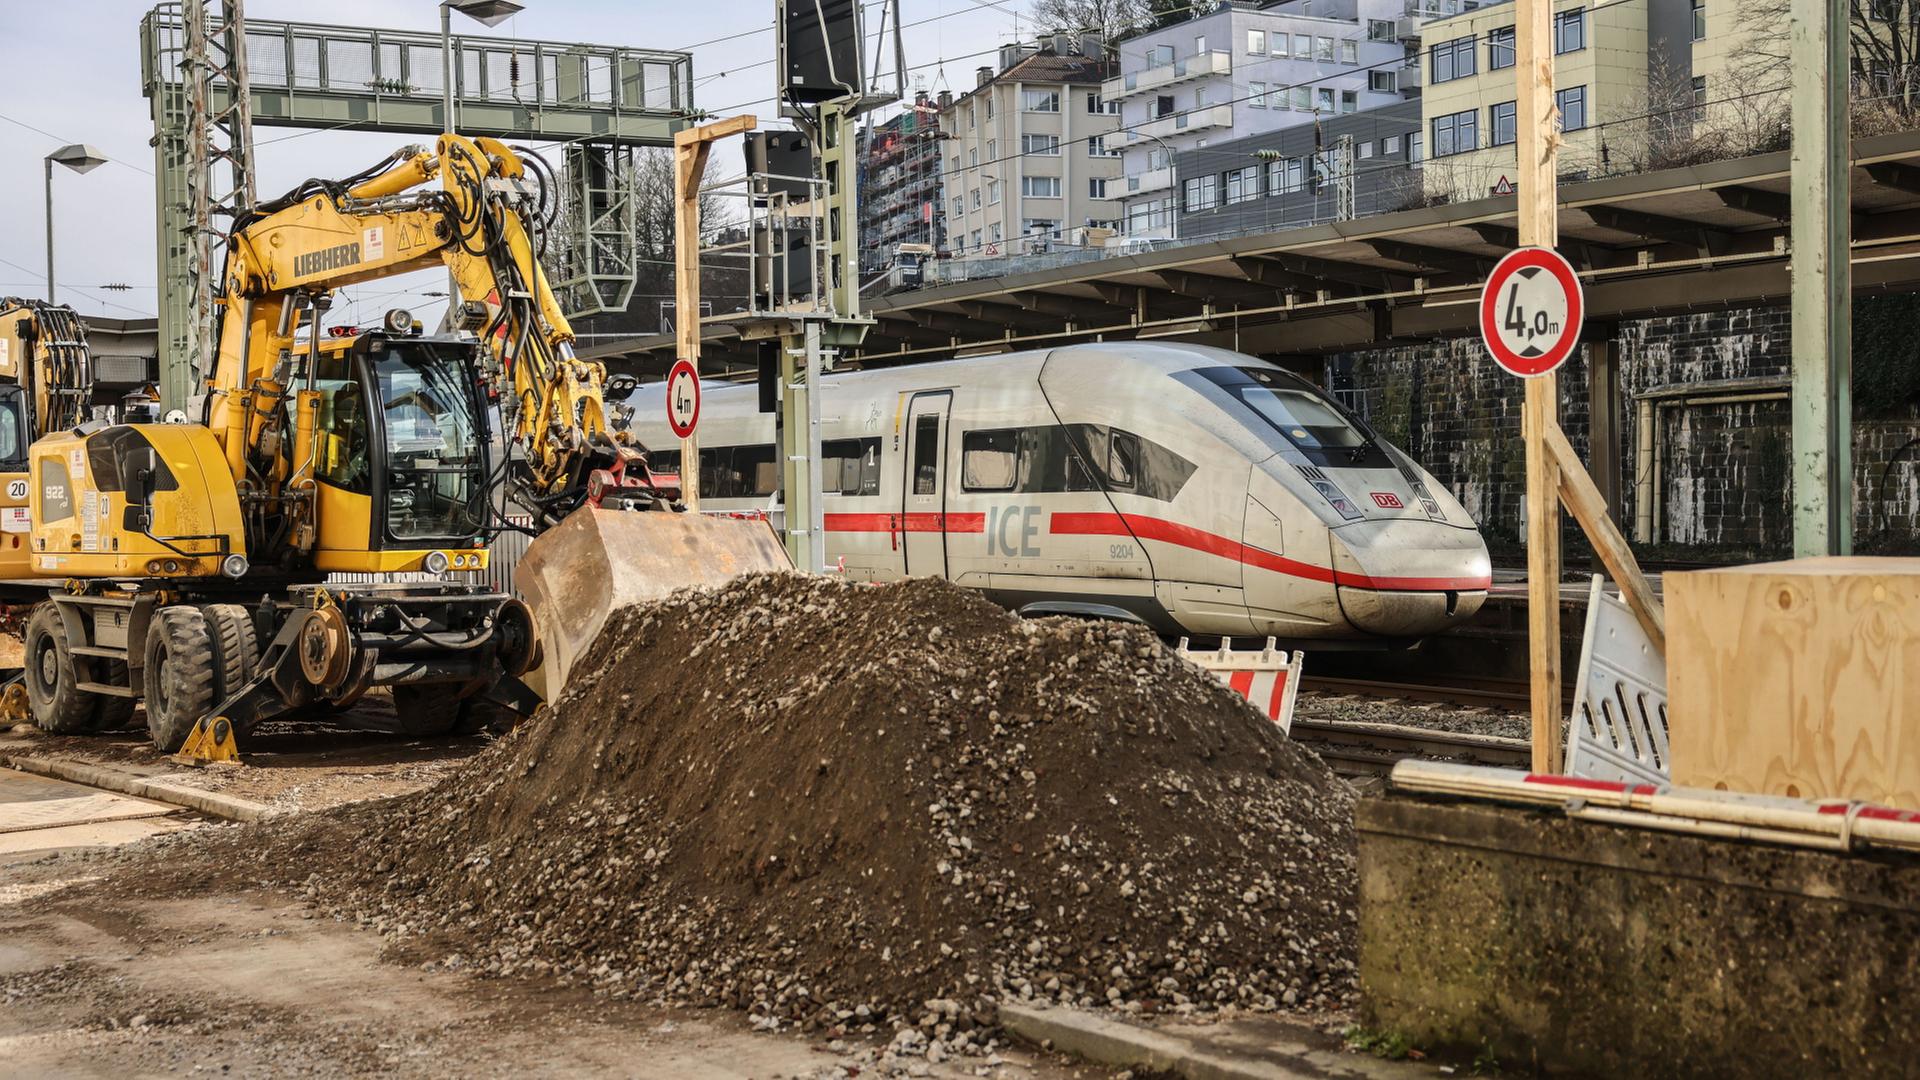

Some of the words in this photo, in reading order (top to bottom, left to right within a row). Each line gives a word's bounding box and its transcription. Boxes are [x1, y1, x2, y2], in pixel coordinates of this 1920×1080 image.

[294, 242, 360, 277] LIEBHERR
[868, 445, 875, 466] 1
[11, 483, 26, 496] 20
[46, 486, 64, 499] 922
[1373, 495, 1401, 507] DB
[987, 505, 1042, 557] ICE
[1110, 544, 1134, 559] 9204
